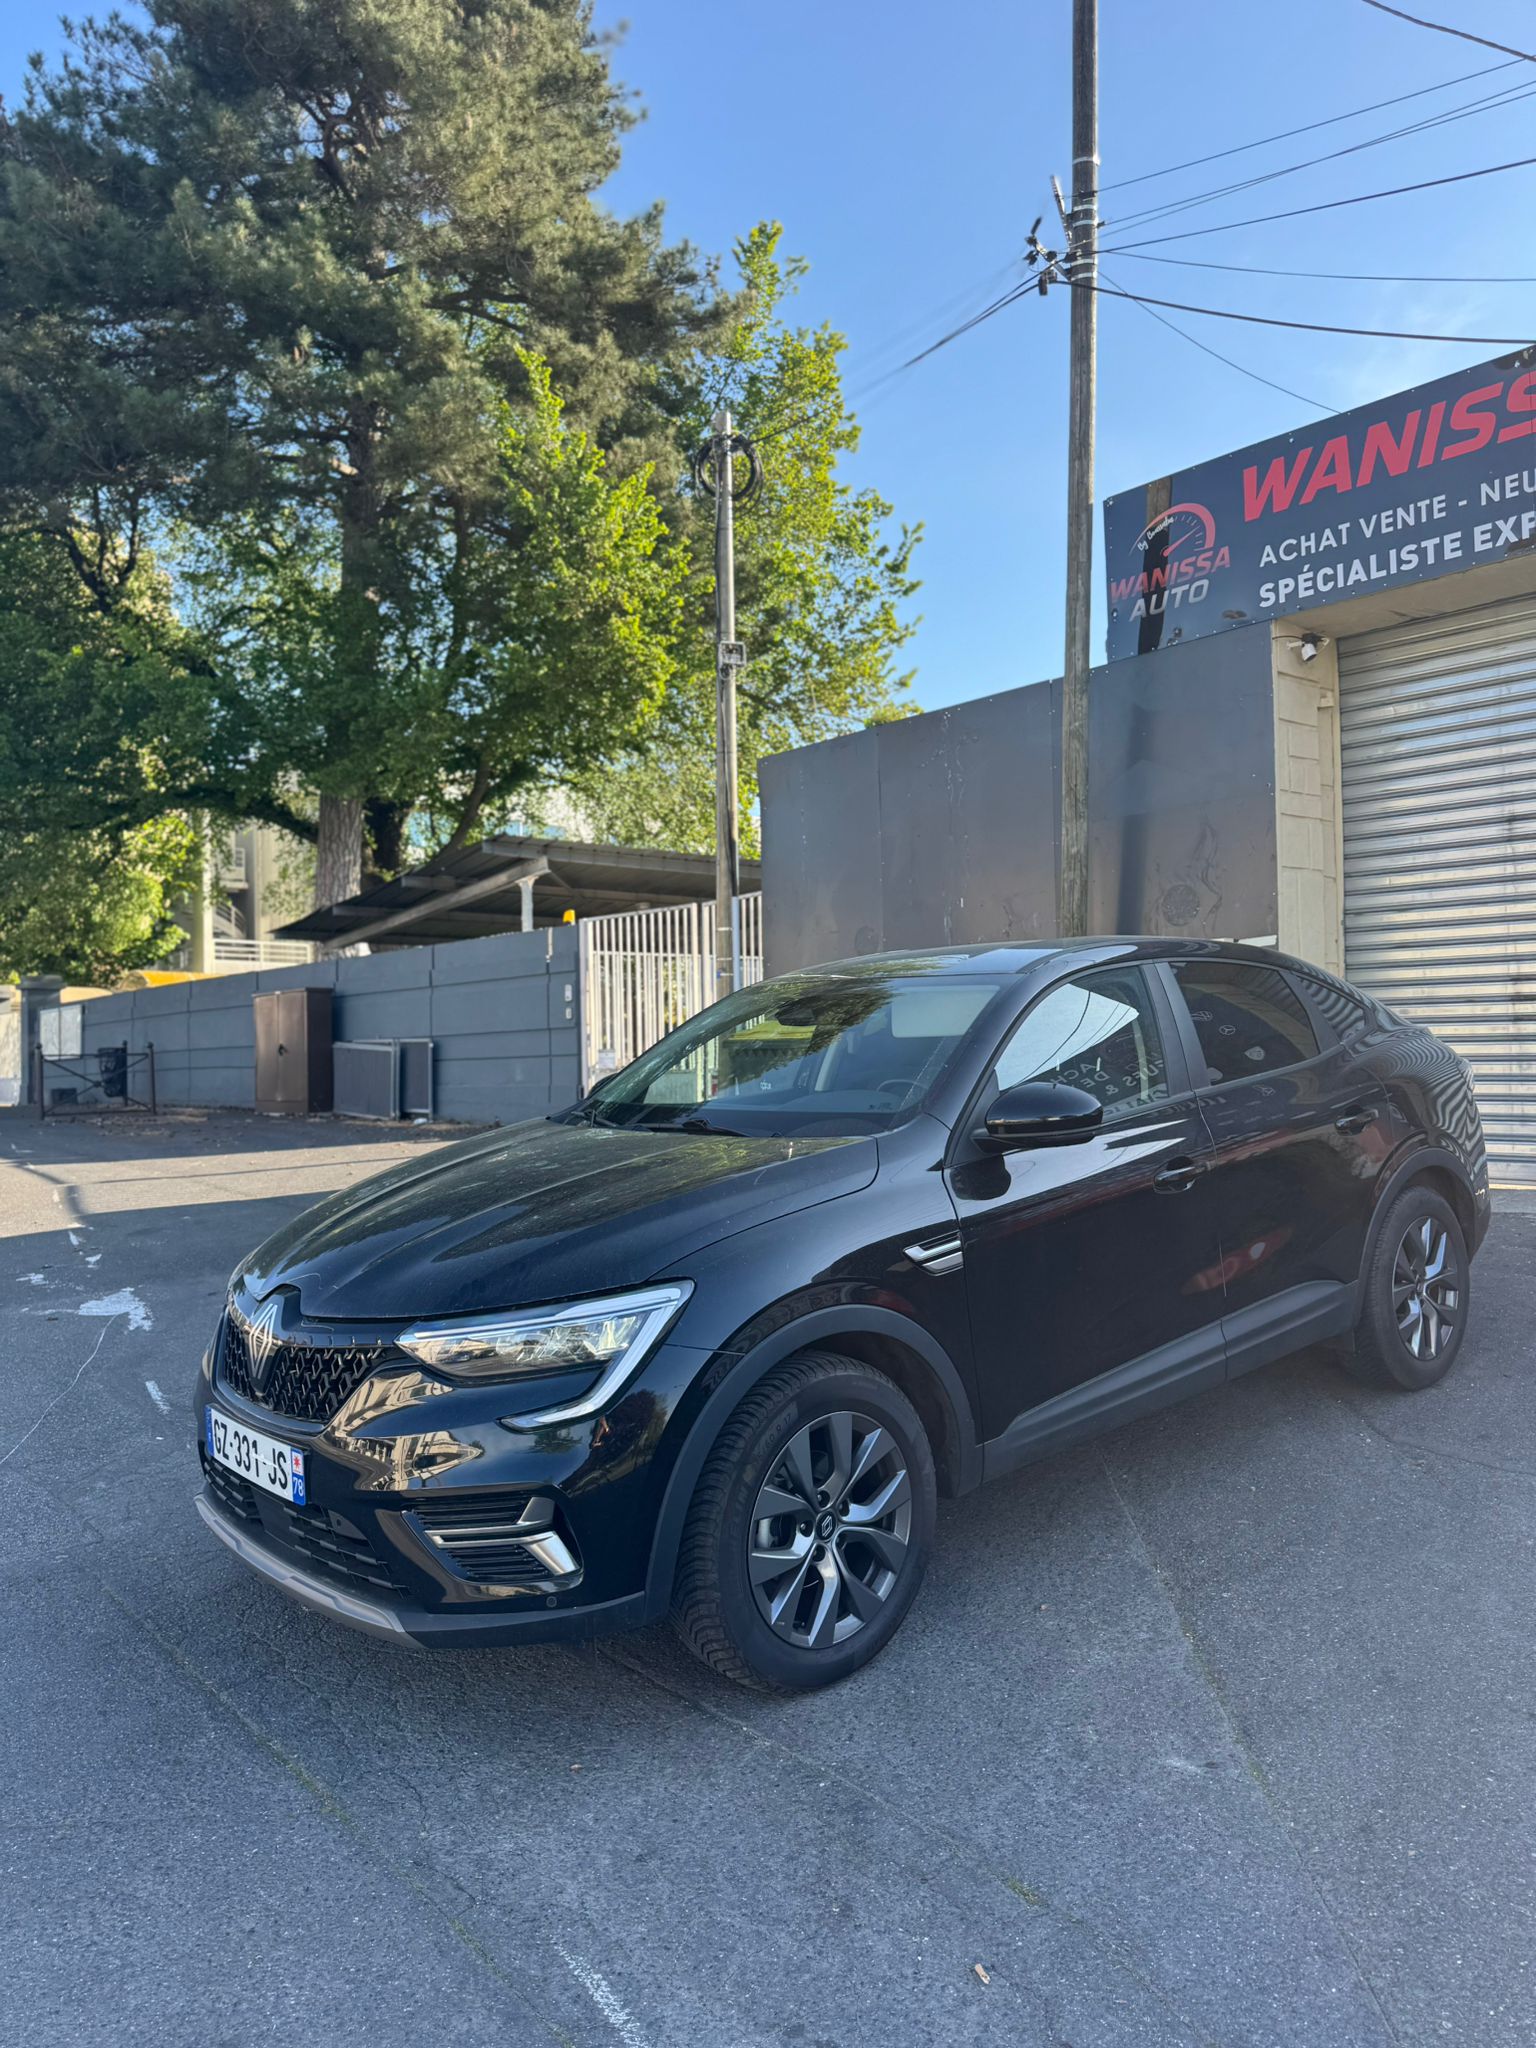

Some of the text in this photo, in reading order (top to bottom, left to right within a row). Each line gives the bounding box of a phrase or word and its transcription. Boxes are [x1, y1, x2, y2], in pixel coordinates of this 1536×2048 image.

[1243, 370, 1536, 522] WANISS
[1259, 522, 1351, 567] ACHAT
[1359, 494, 1446, 539] VENTE
[1480, 468, 1536, 506] NEU
[1111, 545, 1231, 604] WANISSA
[1259, 511, 1536, 608] SPÉCIALISTE EXP
[1129, 579, 1209, 622] AUTO
[293, 1477, 304, 1497] 78
